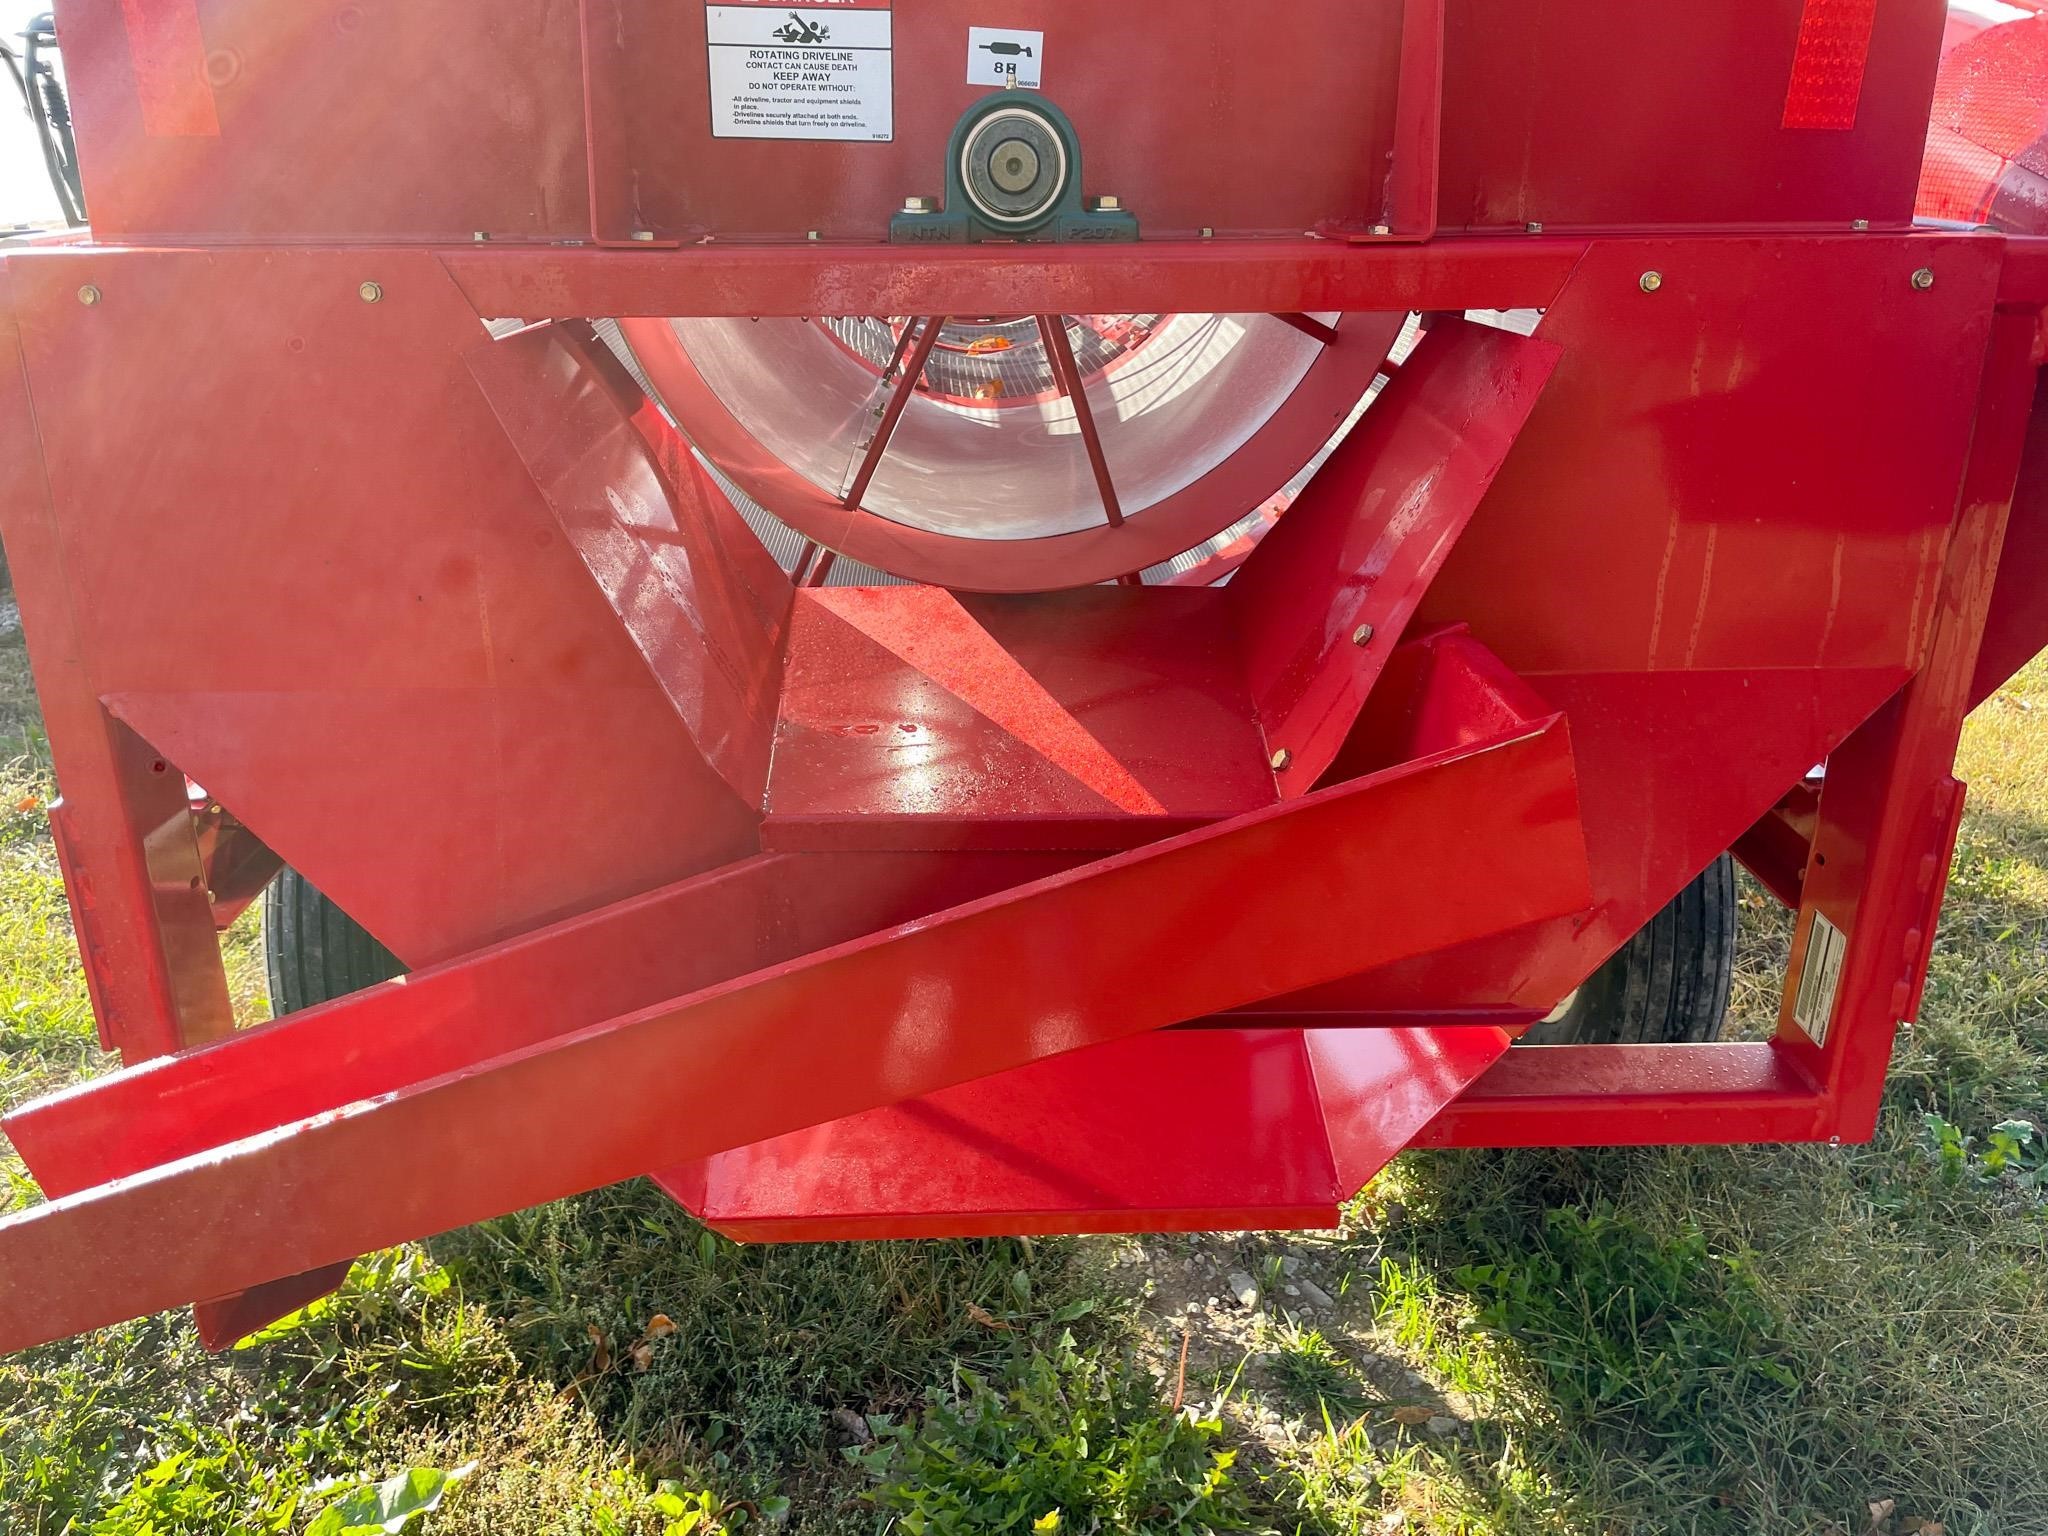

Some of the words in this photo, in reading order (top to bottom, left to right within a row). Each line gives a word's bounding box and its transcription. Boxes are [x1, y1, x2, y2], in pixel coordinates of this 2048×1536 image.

[749, 50, 800, 60] ROTATING
[802, 51, 853, 61] DRIVELINE
[745, 61, 783, 70] CONTACT
[784, 62, 801, 70] CAN
[803, 63, 830, 71] CAUSE
[831, 63, 858, 72] DEATH
[993, 61, 1004, 73] 8
[773, 72, 800, 81] KEEP
[801, 73, 831, 82] AWAY
[748, 82, 760, 90] DO
[780, 83, 817, 91] OPERATE
[818, 84, 856, 92] WITHOUT:
[743, 96, 771, 104] driveline,
[806, 98, 839, 106] equipment
[766, 112, 792, 120] securely
